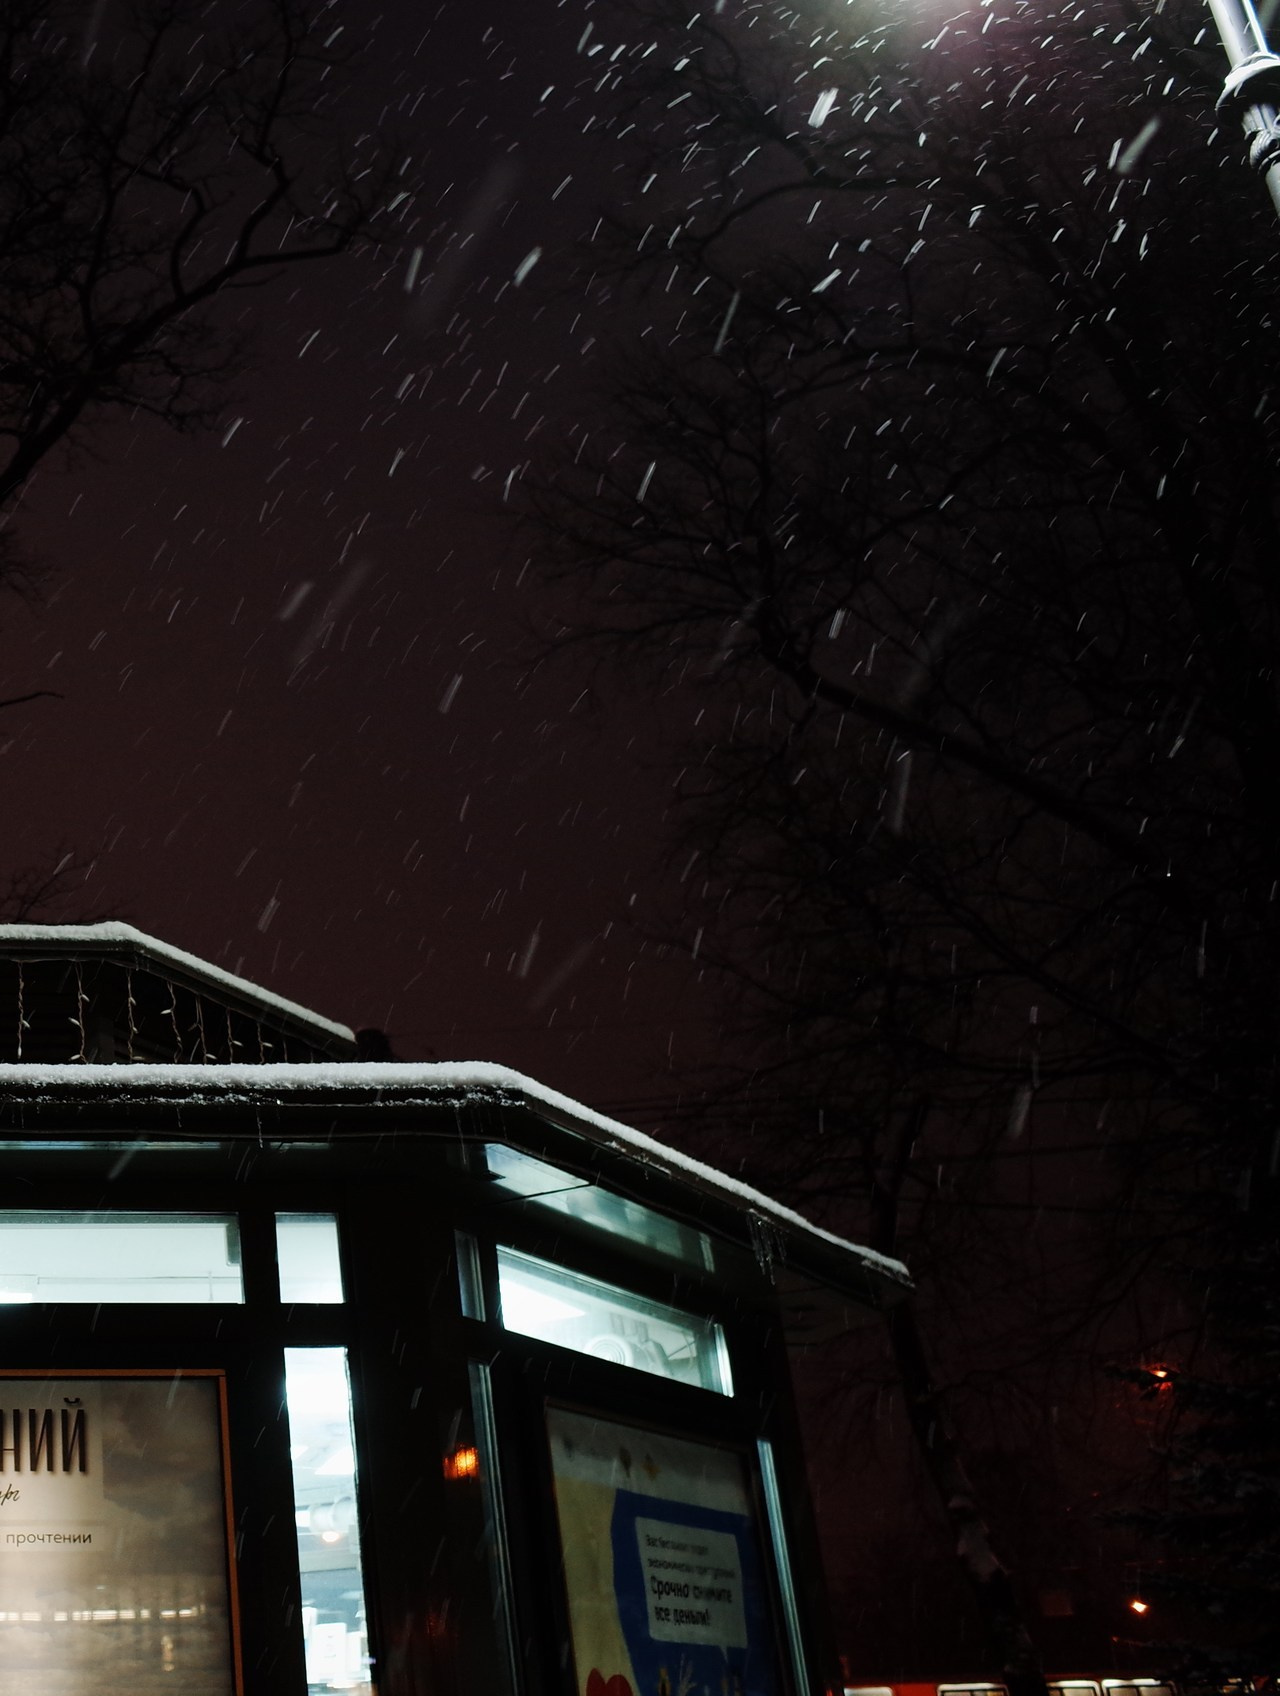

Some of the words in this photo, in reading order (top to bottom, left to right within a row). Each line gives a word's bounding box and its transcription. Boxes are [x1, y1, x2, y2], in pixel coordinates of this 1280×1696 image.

[6, 1533, 92, 1548] прочтении
[650, 1575, 689, 1601] Срочно
[654, 1605, 671, 1622] все
